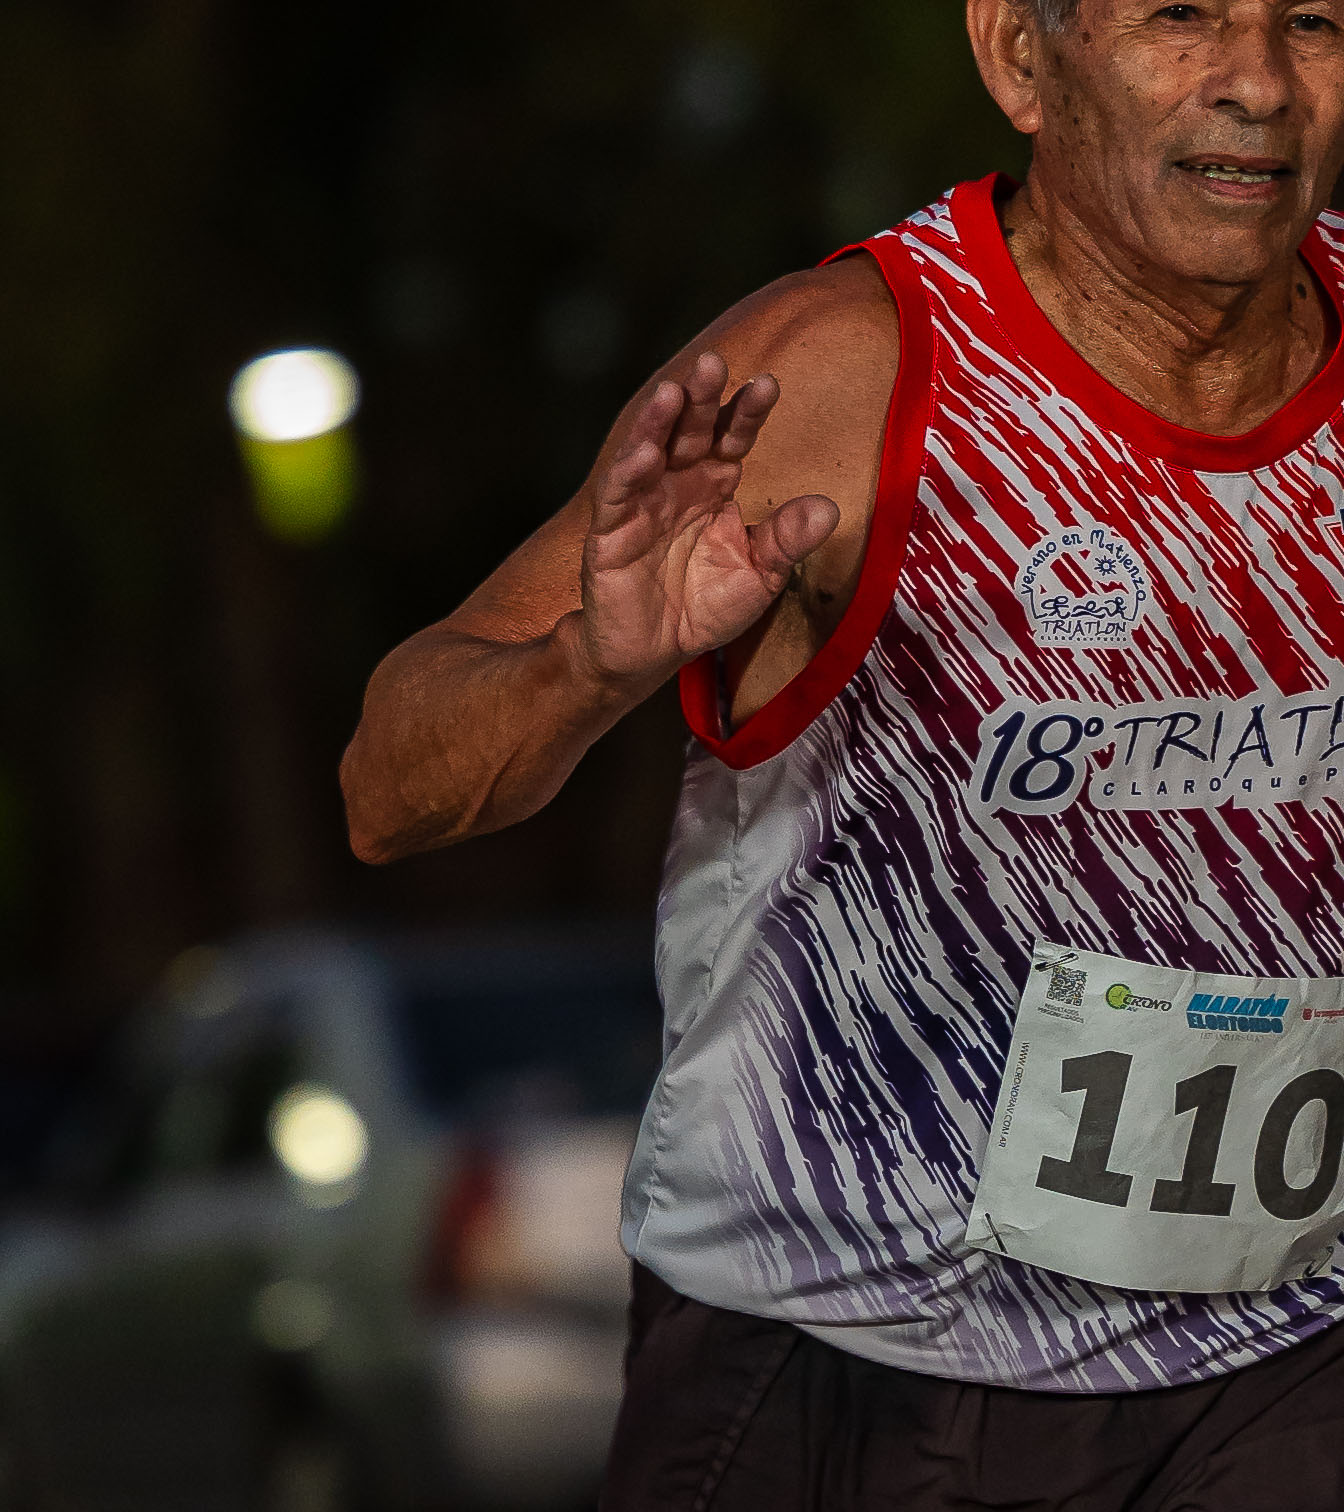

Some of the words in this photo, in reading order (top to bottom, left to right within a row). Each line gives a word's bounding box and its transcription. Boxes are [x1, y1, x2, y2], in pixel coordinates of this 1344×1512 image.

[1061, 533, 1083, 545] en
[1090, 529, 1146, 601] Matienzo
[1041, 619, 1127, 640] TRIATLON
[1186, 993, 1290, 1017] MARATÓN
